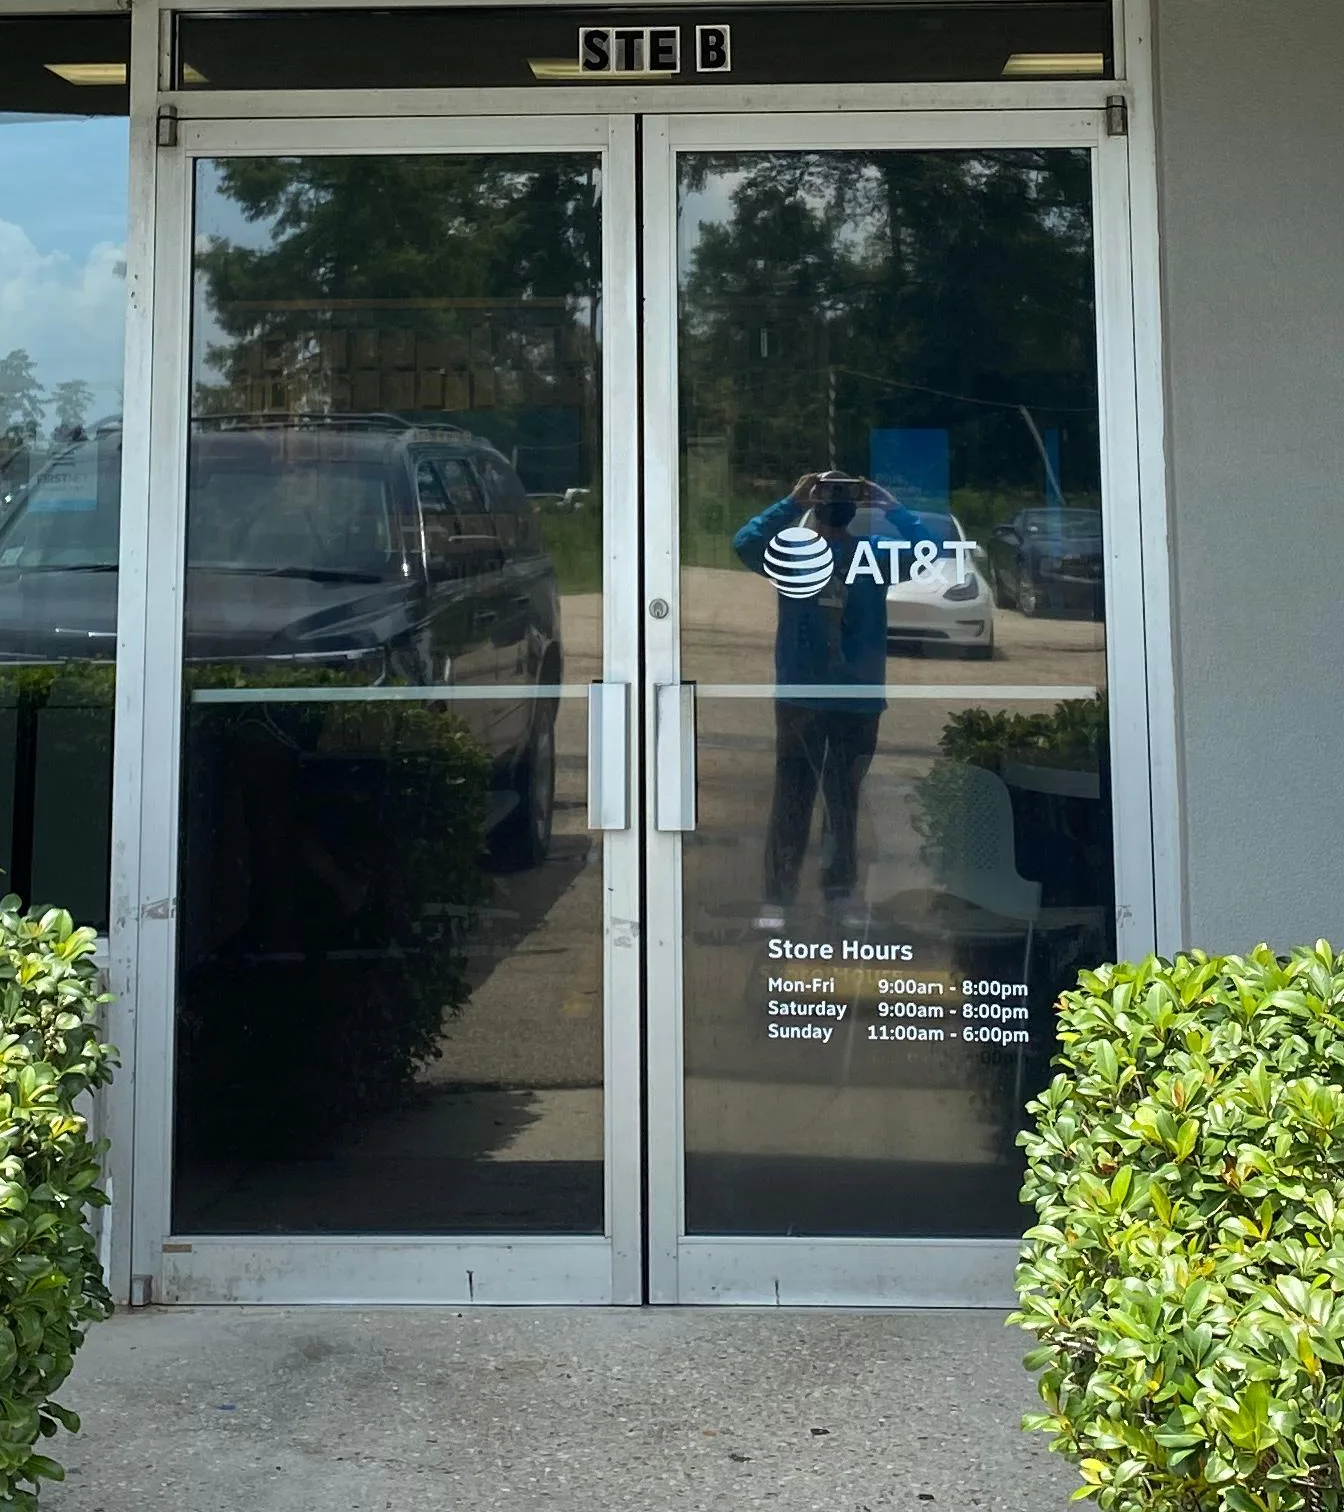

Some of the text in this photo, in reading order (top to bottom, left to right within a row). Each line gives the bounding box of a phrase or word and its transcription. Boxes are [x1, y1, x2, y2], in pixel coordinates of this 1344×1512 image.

[581, 27, 728, 72] STE B
[845, 539, 977, 585] AT&T
[768, 938, 914, 961] Store Hours
[768, 977, 835, 994] Mon-Fri
[877, 979, 944, 996] 9:00am
[962, 980, 1029, 1000] 8:00pm
[768, 1000, 848, 1020] Saturday
[877, 1002, 944, 1018] 9:00am
[962, 1003, 1029, 1023] 8:00pm
[768, 1023, 833, 1044] Sunday
[867, 1025, 944, 1041] 11:00am
[963, 1026, 1029, 1047] 6:00pm
